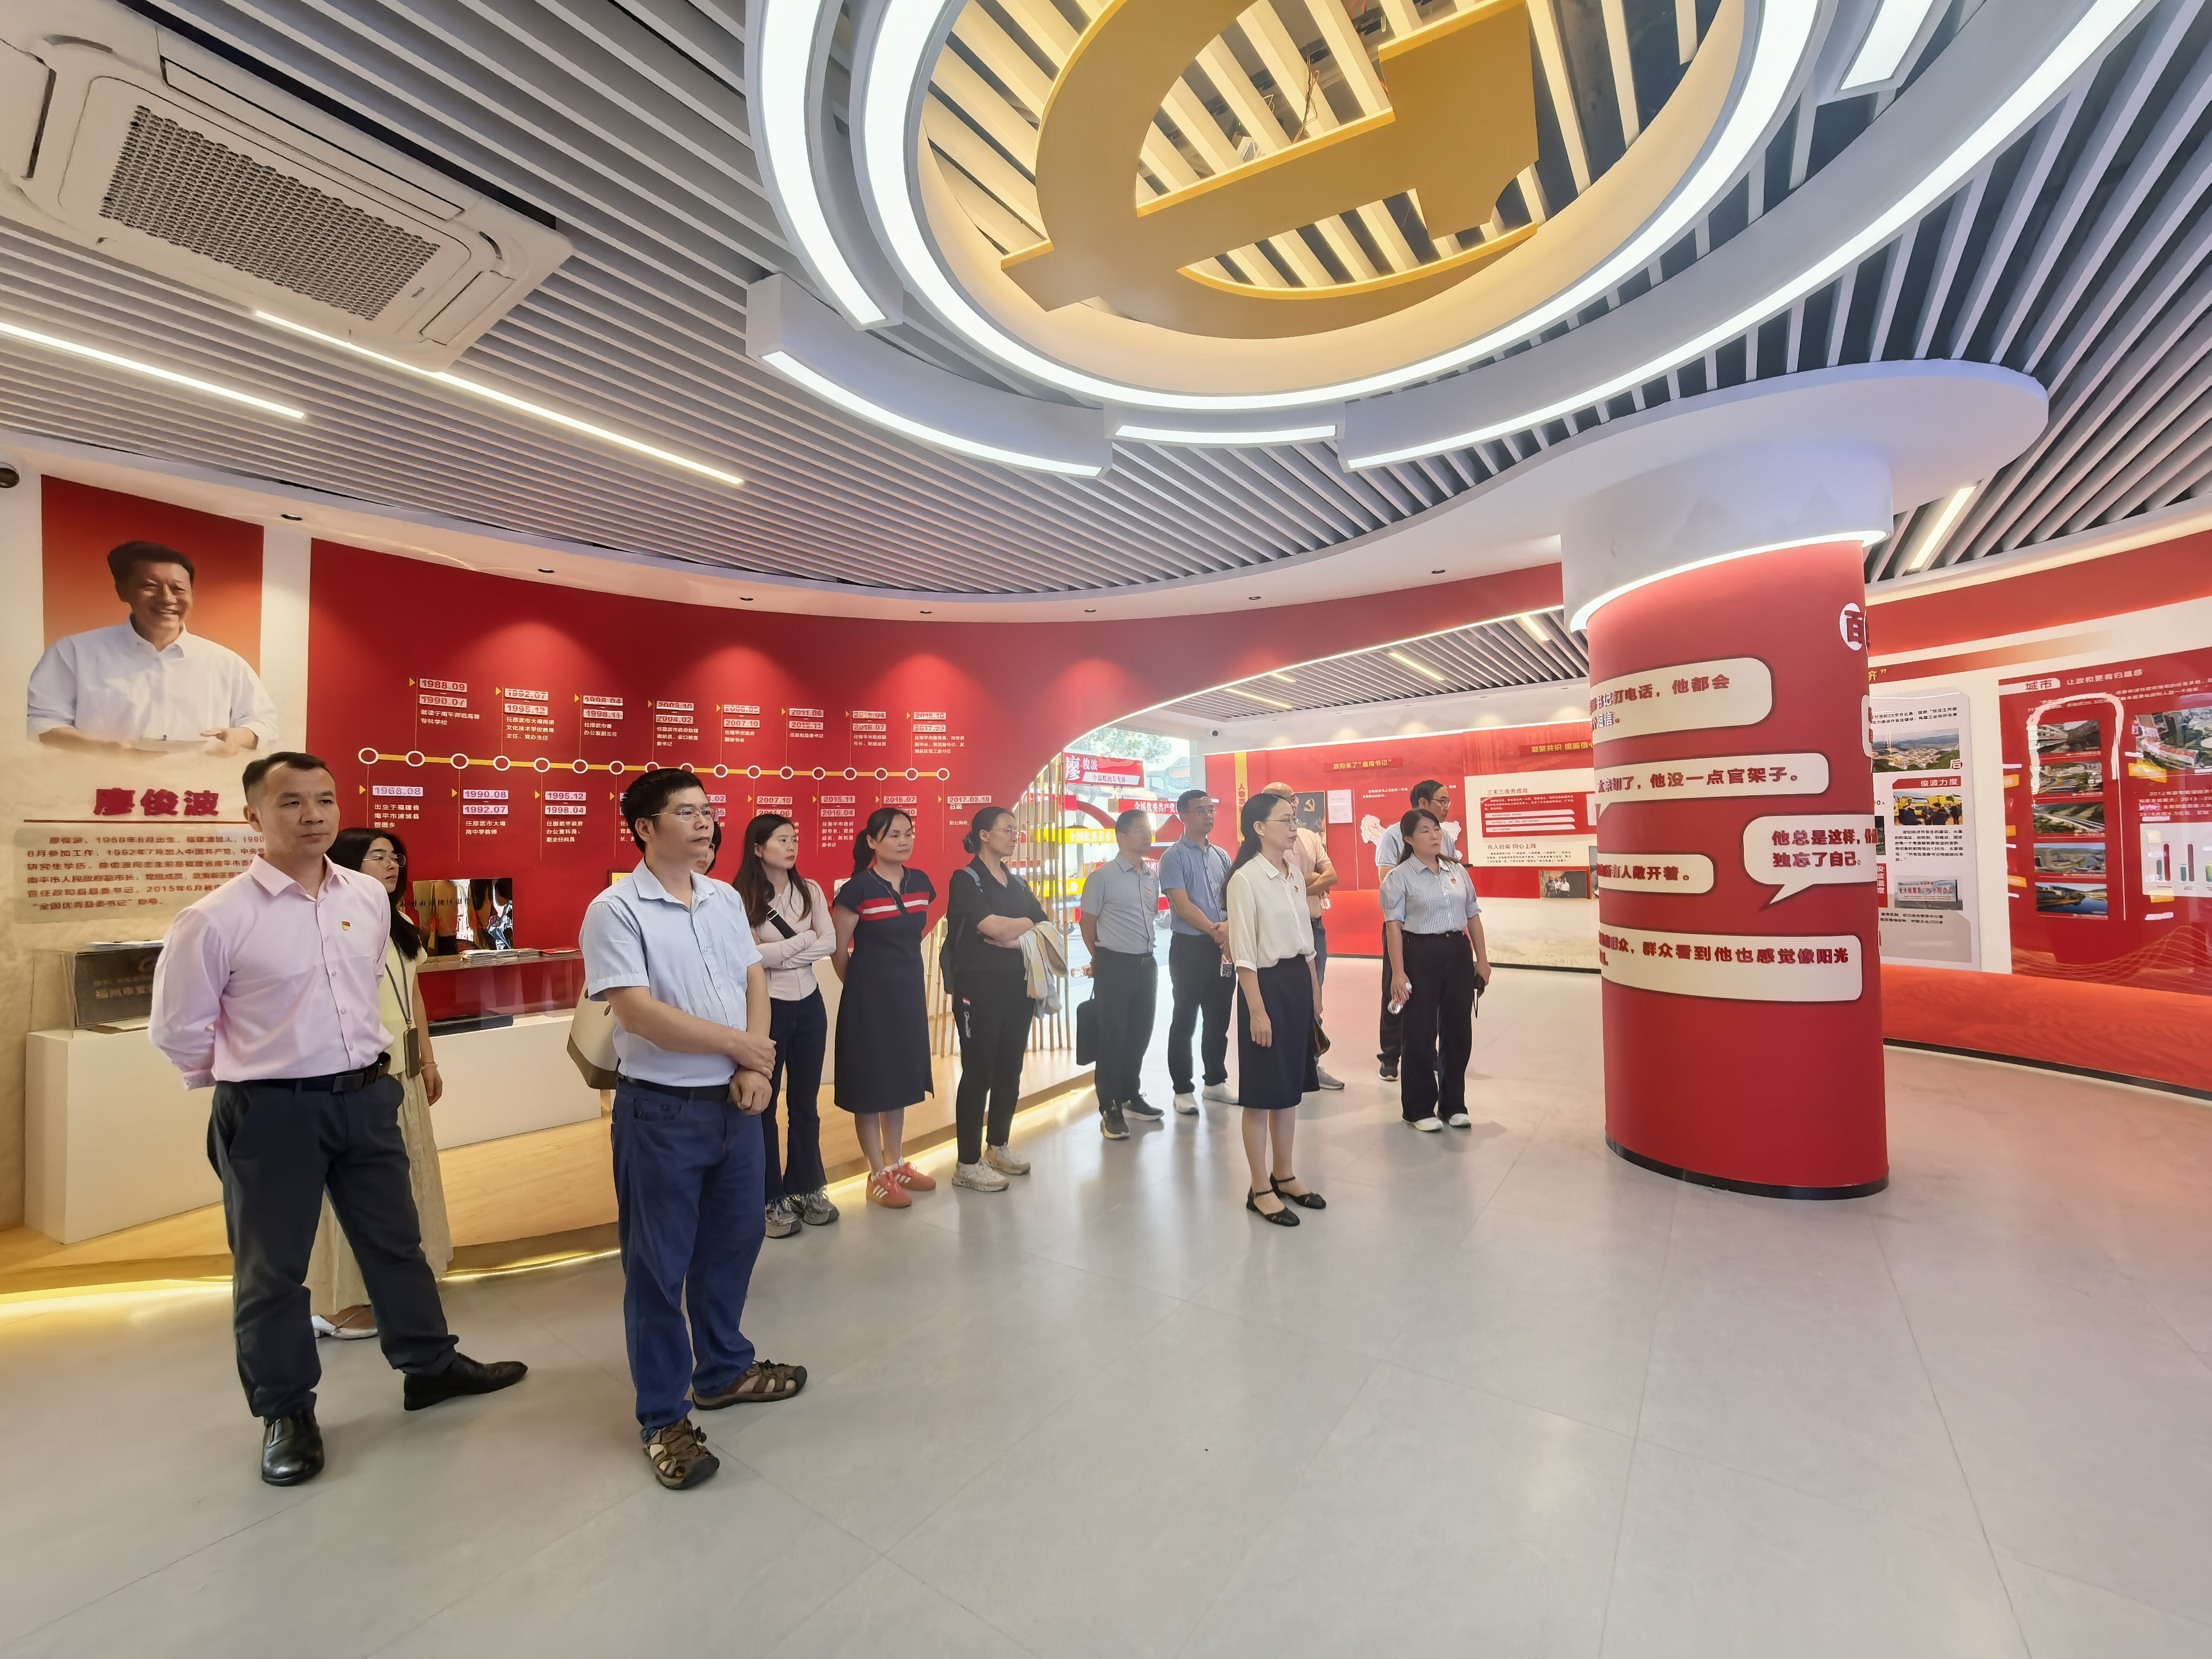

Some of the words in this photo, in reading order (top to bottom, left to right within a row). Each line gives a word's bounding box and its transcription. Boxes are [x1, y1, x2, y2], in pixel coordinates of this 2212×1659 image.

[421, 679, 466, 691] 1988.09
[2026, 680, 2052, 691] 城市
[507, 689, 547, 699] 1992.07
[421, 696, 465, 706] 1990.07
[507, 705, 545, 714] 1995.12
[464, 806, 506, 814] 1992.07
[1134, 801, 1178, 813] 全国优秀共产党
[1772, 851, 1861, 867] 独忘了自己。
